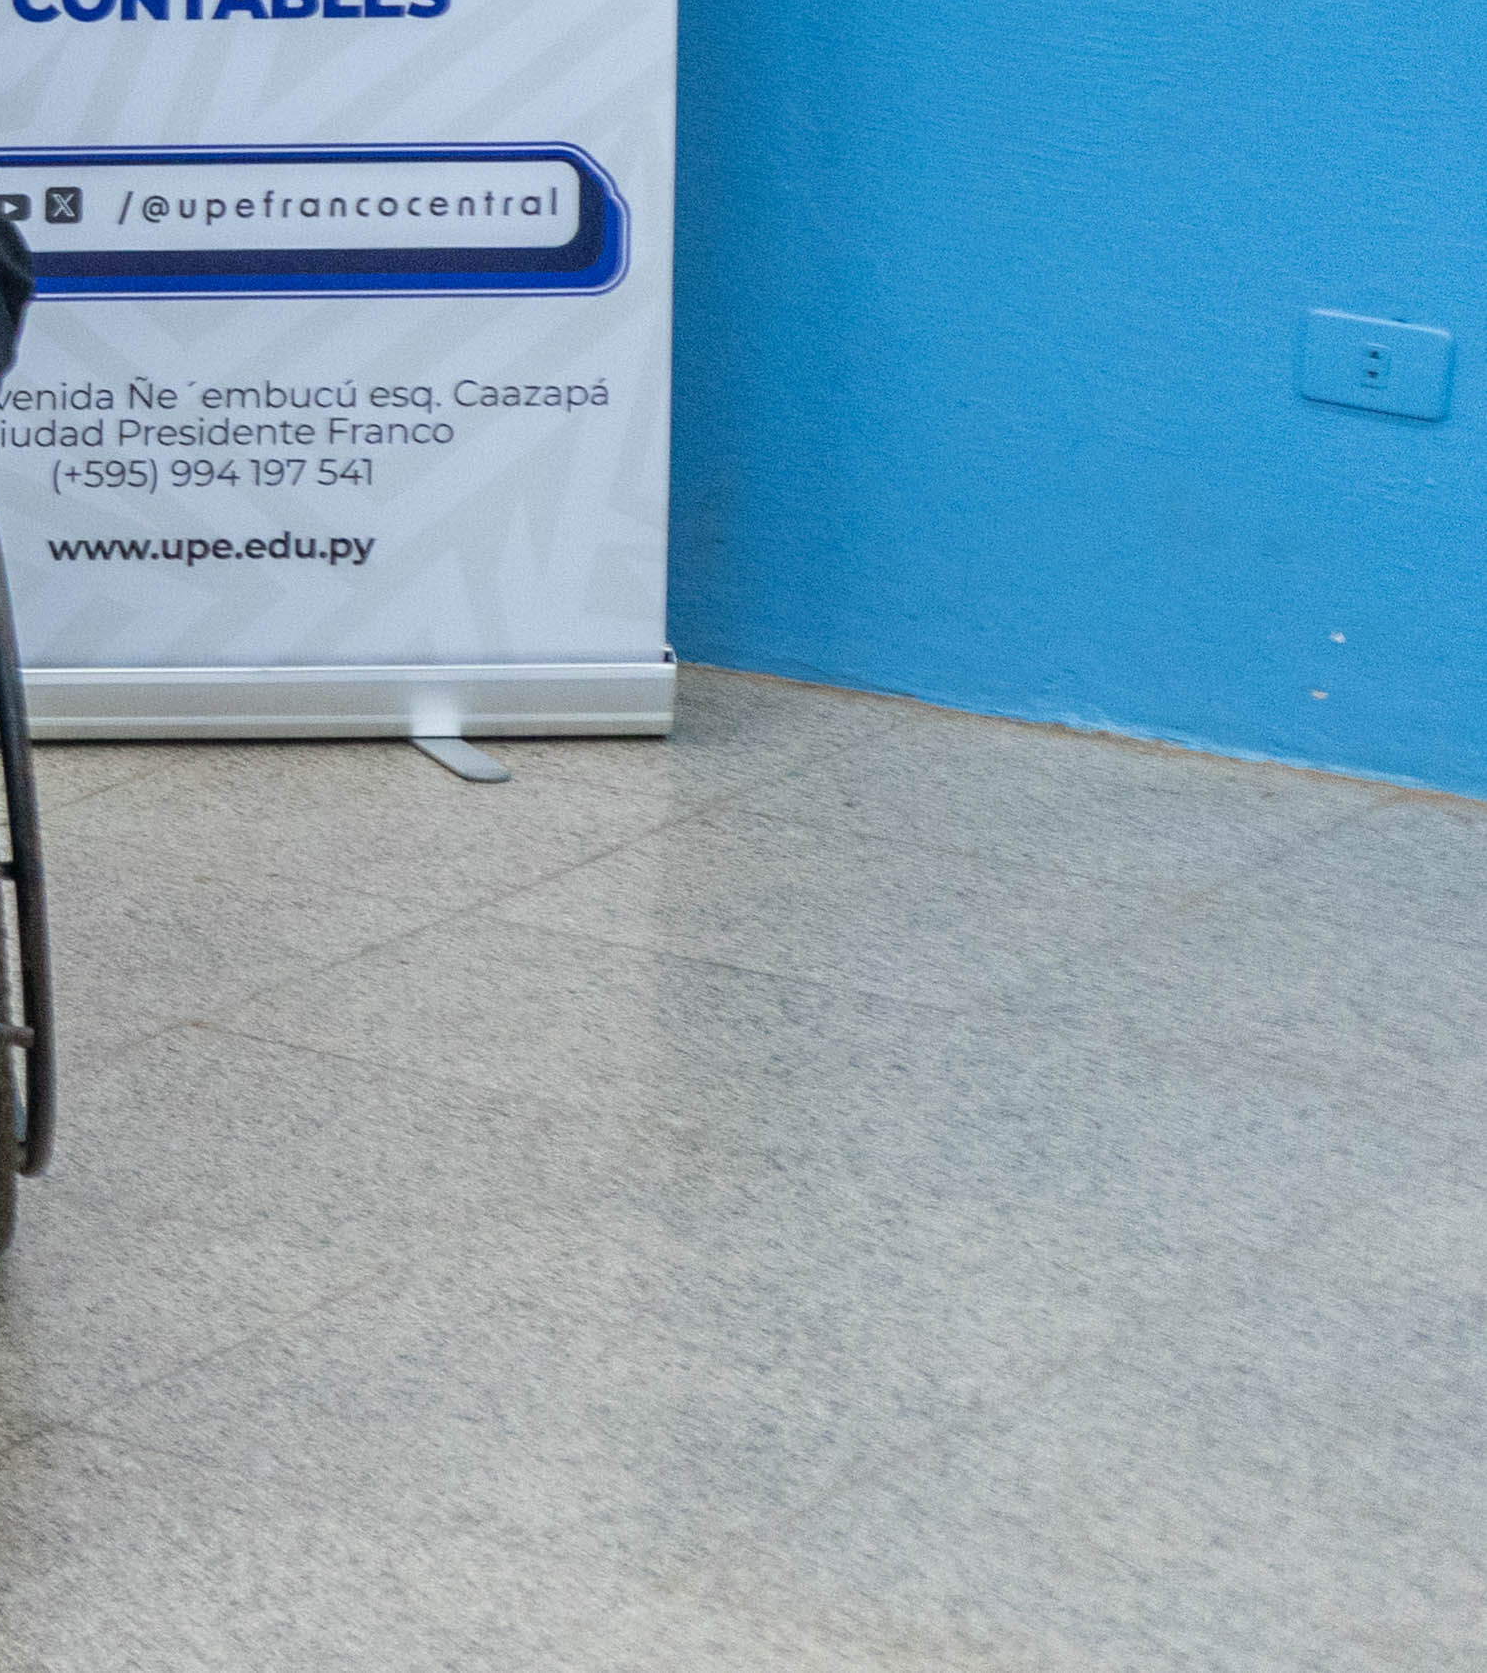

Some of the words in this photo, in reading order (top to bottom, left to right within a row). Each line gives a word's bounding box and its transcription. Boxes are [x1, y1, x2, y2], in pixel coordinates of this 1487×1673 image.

[369, 386, 441, 413] esq.
[454, 380, 608, 412] Caazapá
[119, 418, 315, 446] Presidente
[329, 417, 454, 444] Franco
[53, 459, 157, 495] (+595)
[171, 459, 240, 487] 994
[249, 459, 306, 486] 197
[317, 458, 372, 486] 541
[48, 533, 375, 567] www.upe.edu.py
